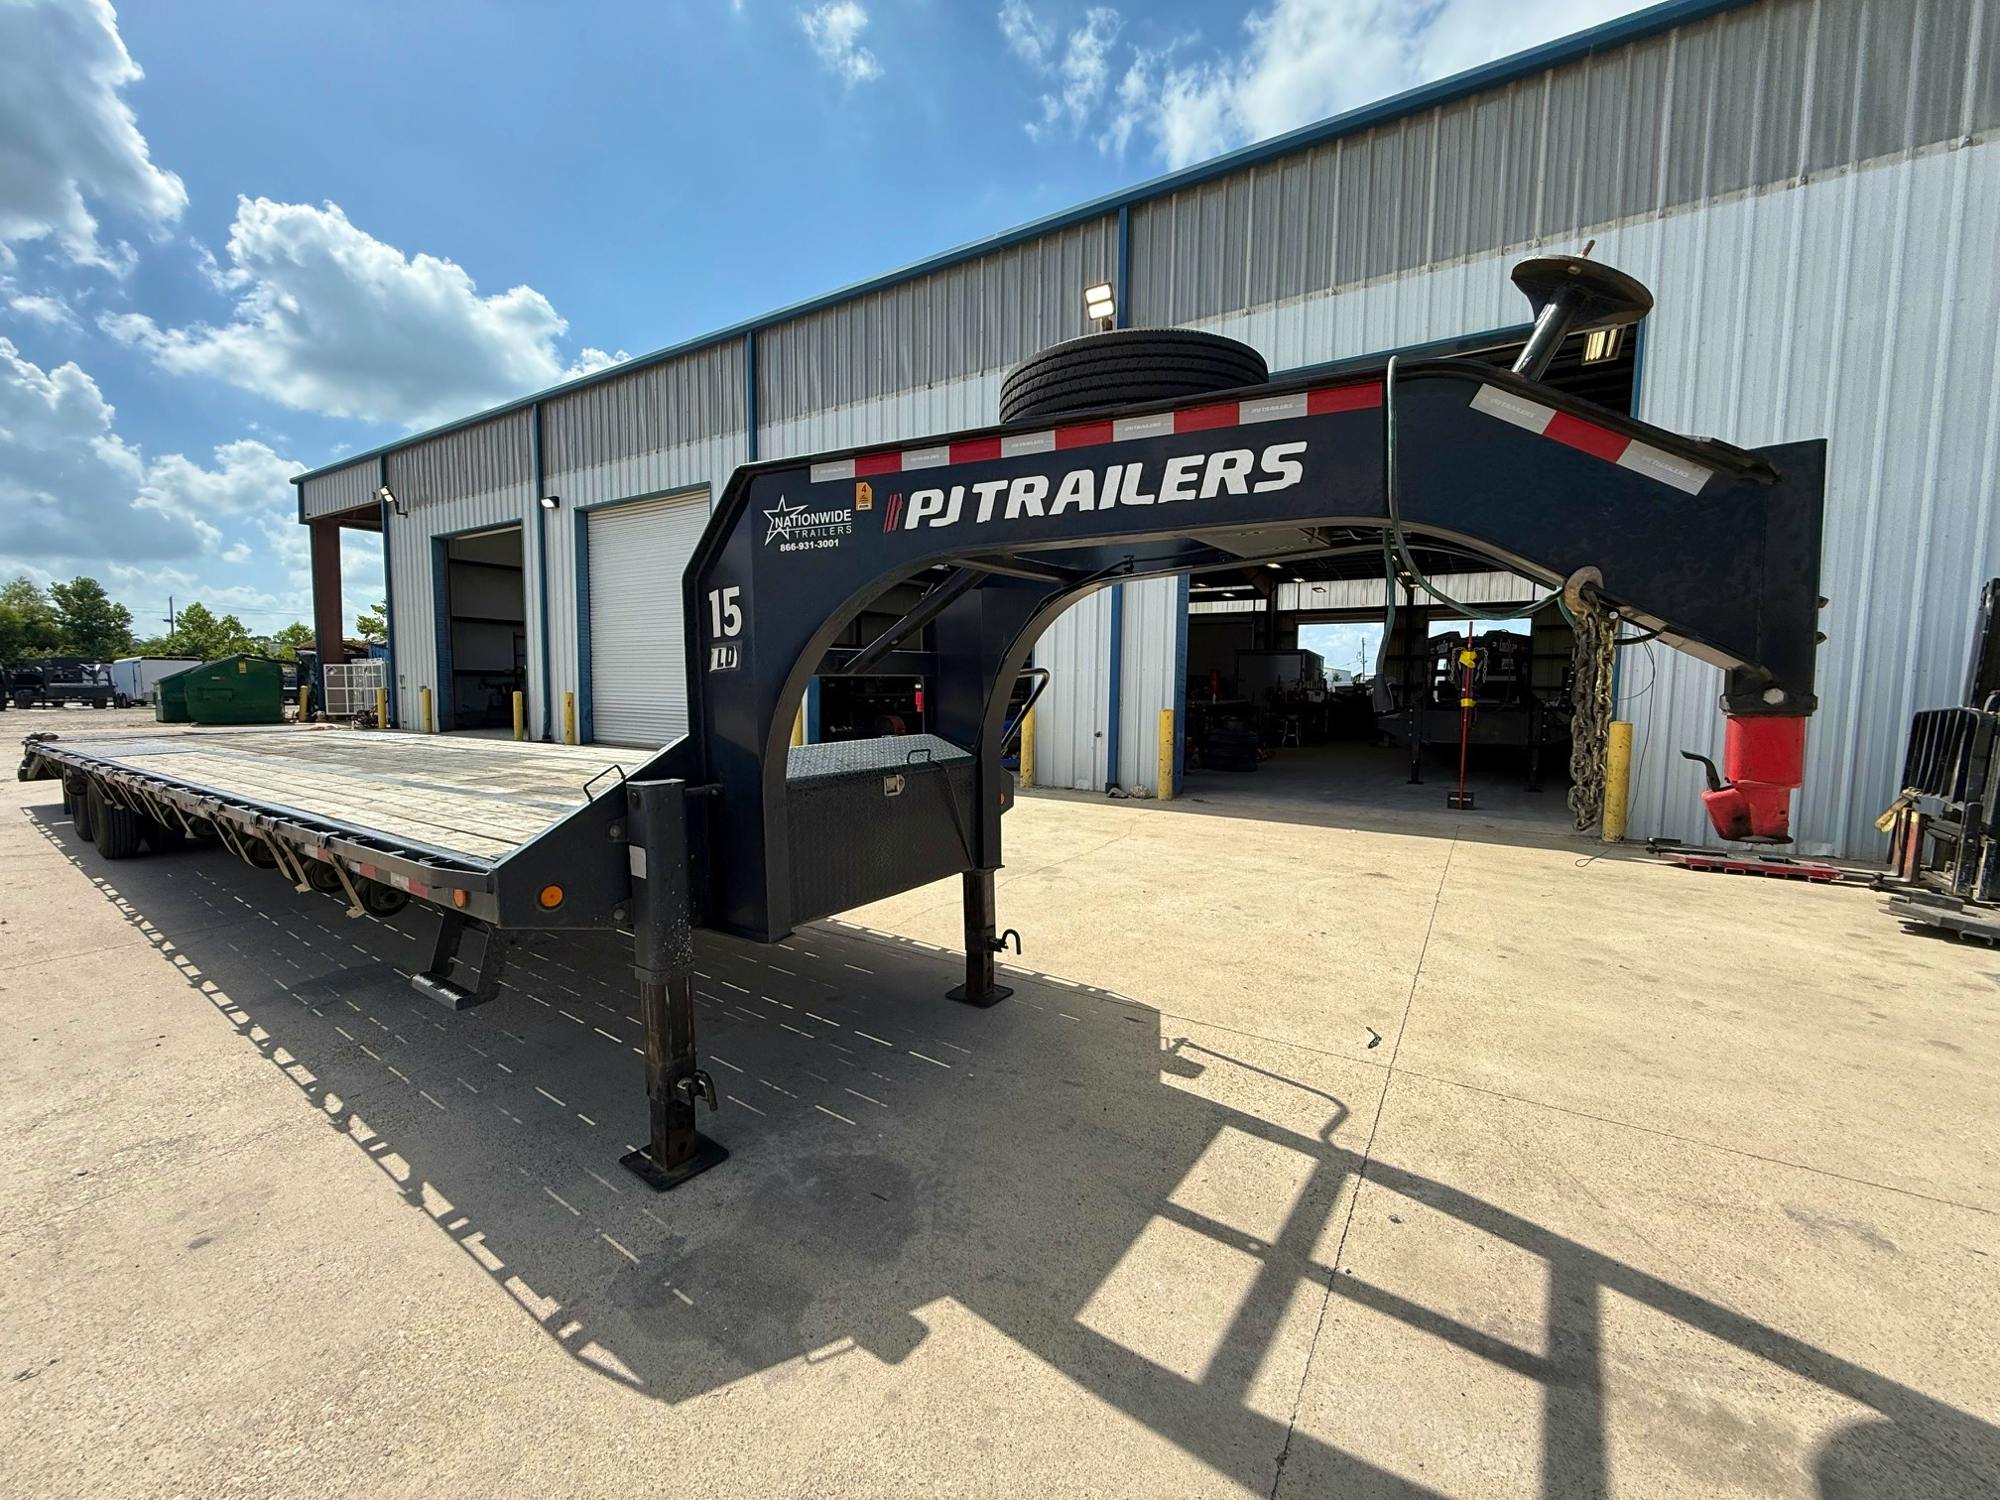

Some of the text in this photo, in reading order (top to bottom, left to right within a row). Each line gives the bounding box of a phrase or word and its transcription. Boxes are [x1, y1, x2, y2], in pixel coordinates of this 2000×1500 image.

[861, 484, 867, 493] 4
[972, 441, 1308, 524] TRAILERS
[775, 509, 852, 528] NATIONWIDE
[795, 525, 852, 539] TRAILERS
[780, 538, 839, 552] 866-931-3001
[708, 586, 742, 638] 15
